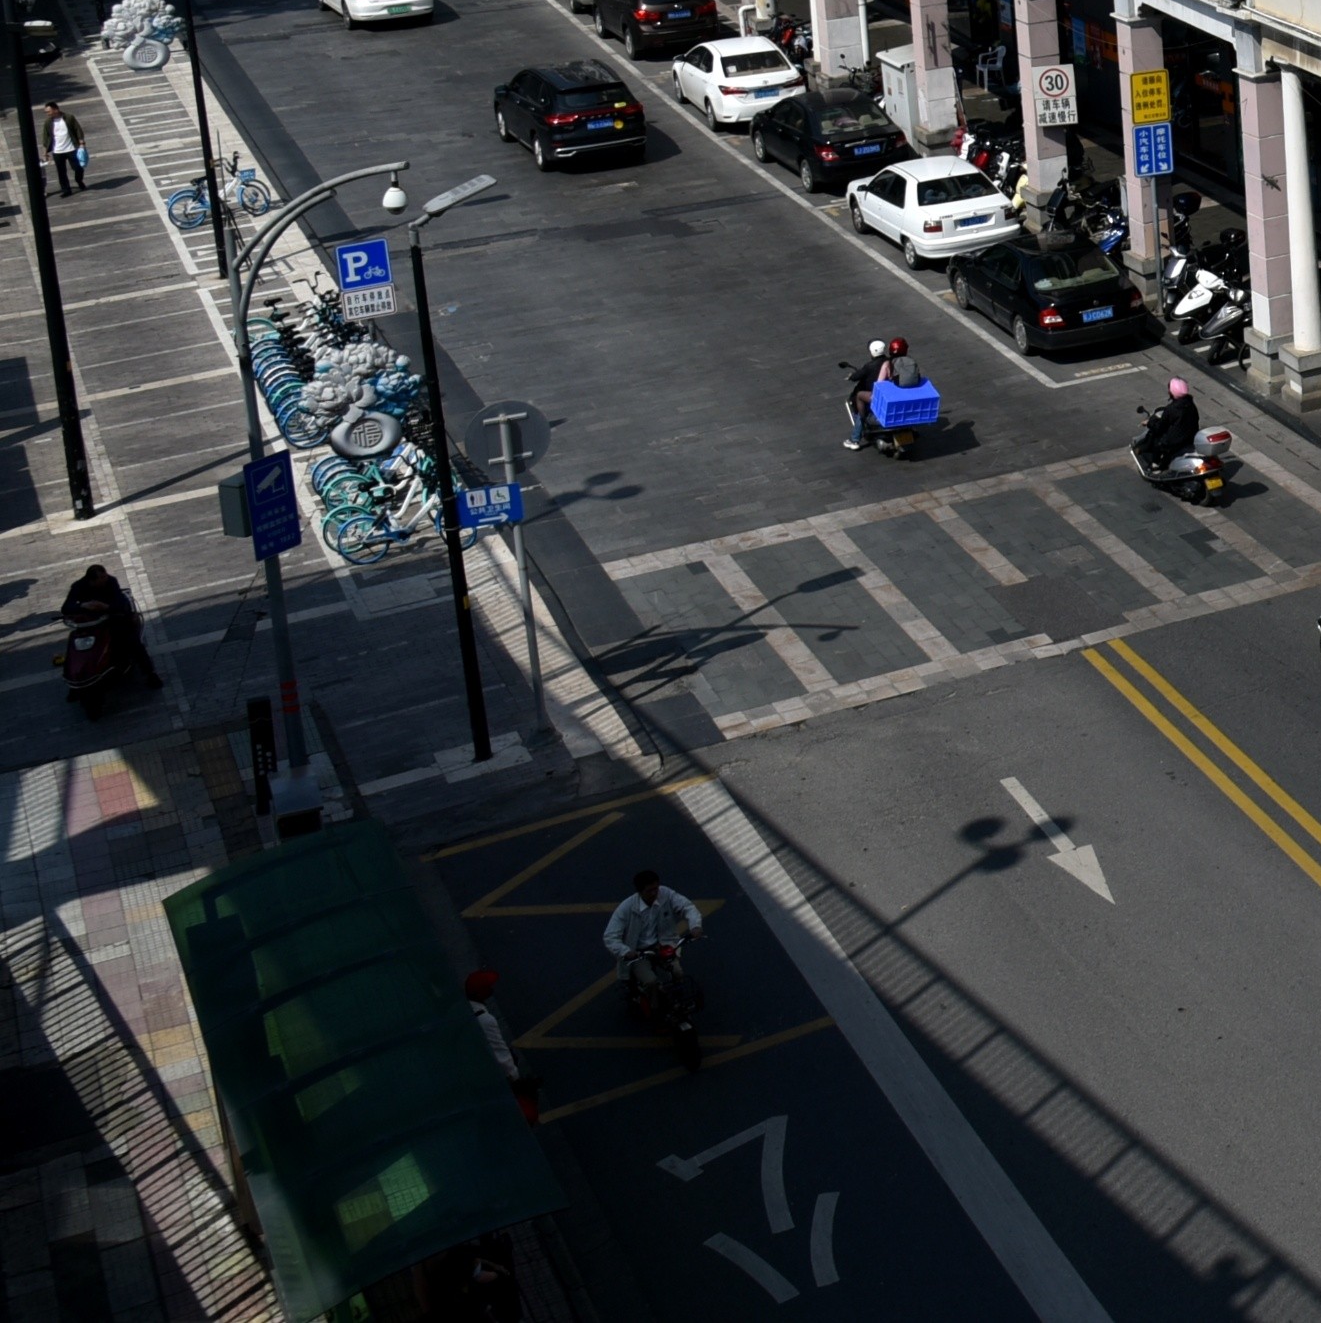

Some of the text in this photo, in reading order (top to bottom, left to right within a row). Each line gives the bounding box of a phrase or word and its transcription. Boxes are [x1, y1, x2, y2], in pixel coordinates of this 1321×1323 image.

[1045, 74, 1064, 91] 30
[1042, 98, 1070, 111] 请车辆
[1038, 110, 1076, 124] 减速慢行
[342, 251, 368, 283] P
